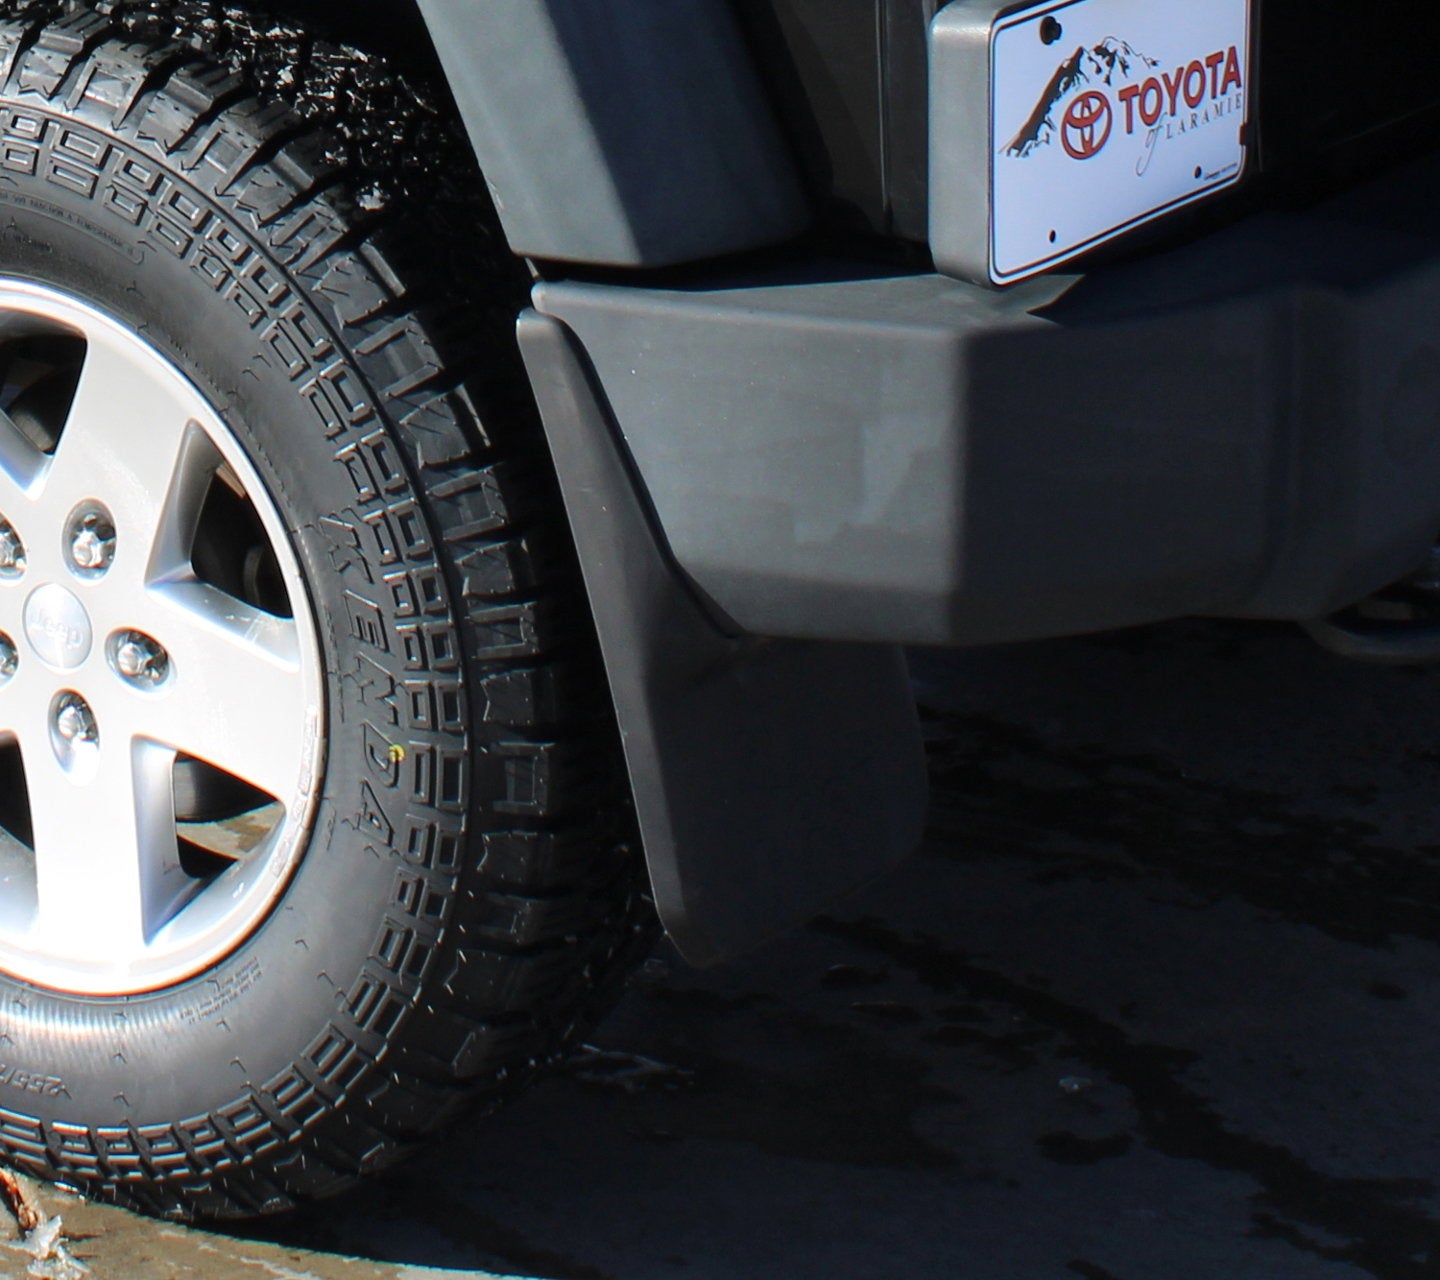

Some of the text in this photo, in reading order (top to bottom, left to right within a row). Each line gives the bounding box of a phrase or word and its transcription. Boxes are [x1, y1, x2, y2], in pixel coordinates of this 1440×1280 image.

[1118, 45, 1242, 135] TOYOTA
[1165, 92, 1243, 140] LARAMIE
[319, 515, 401, 847] KENDA
